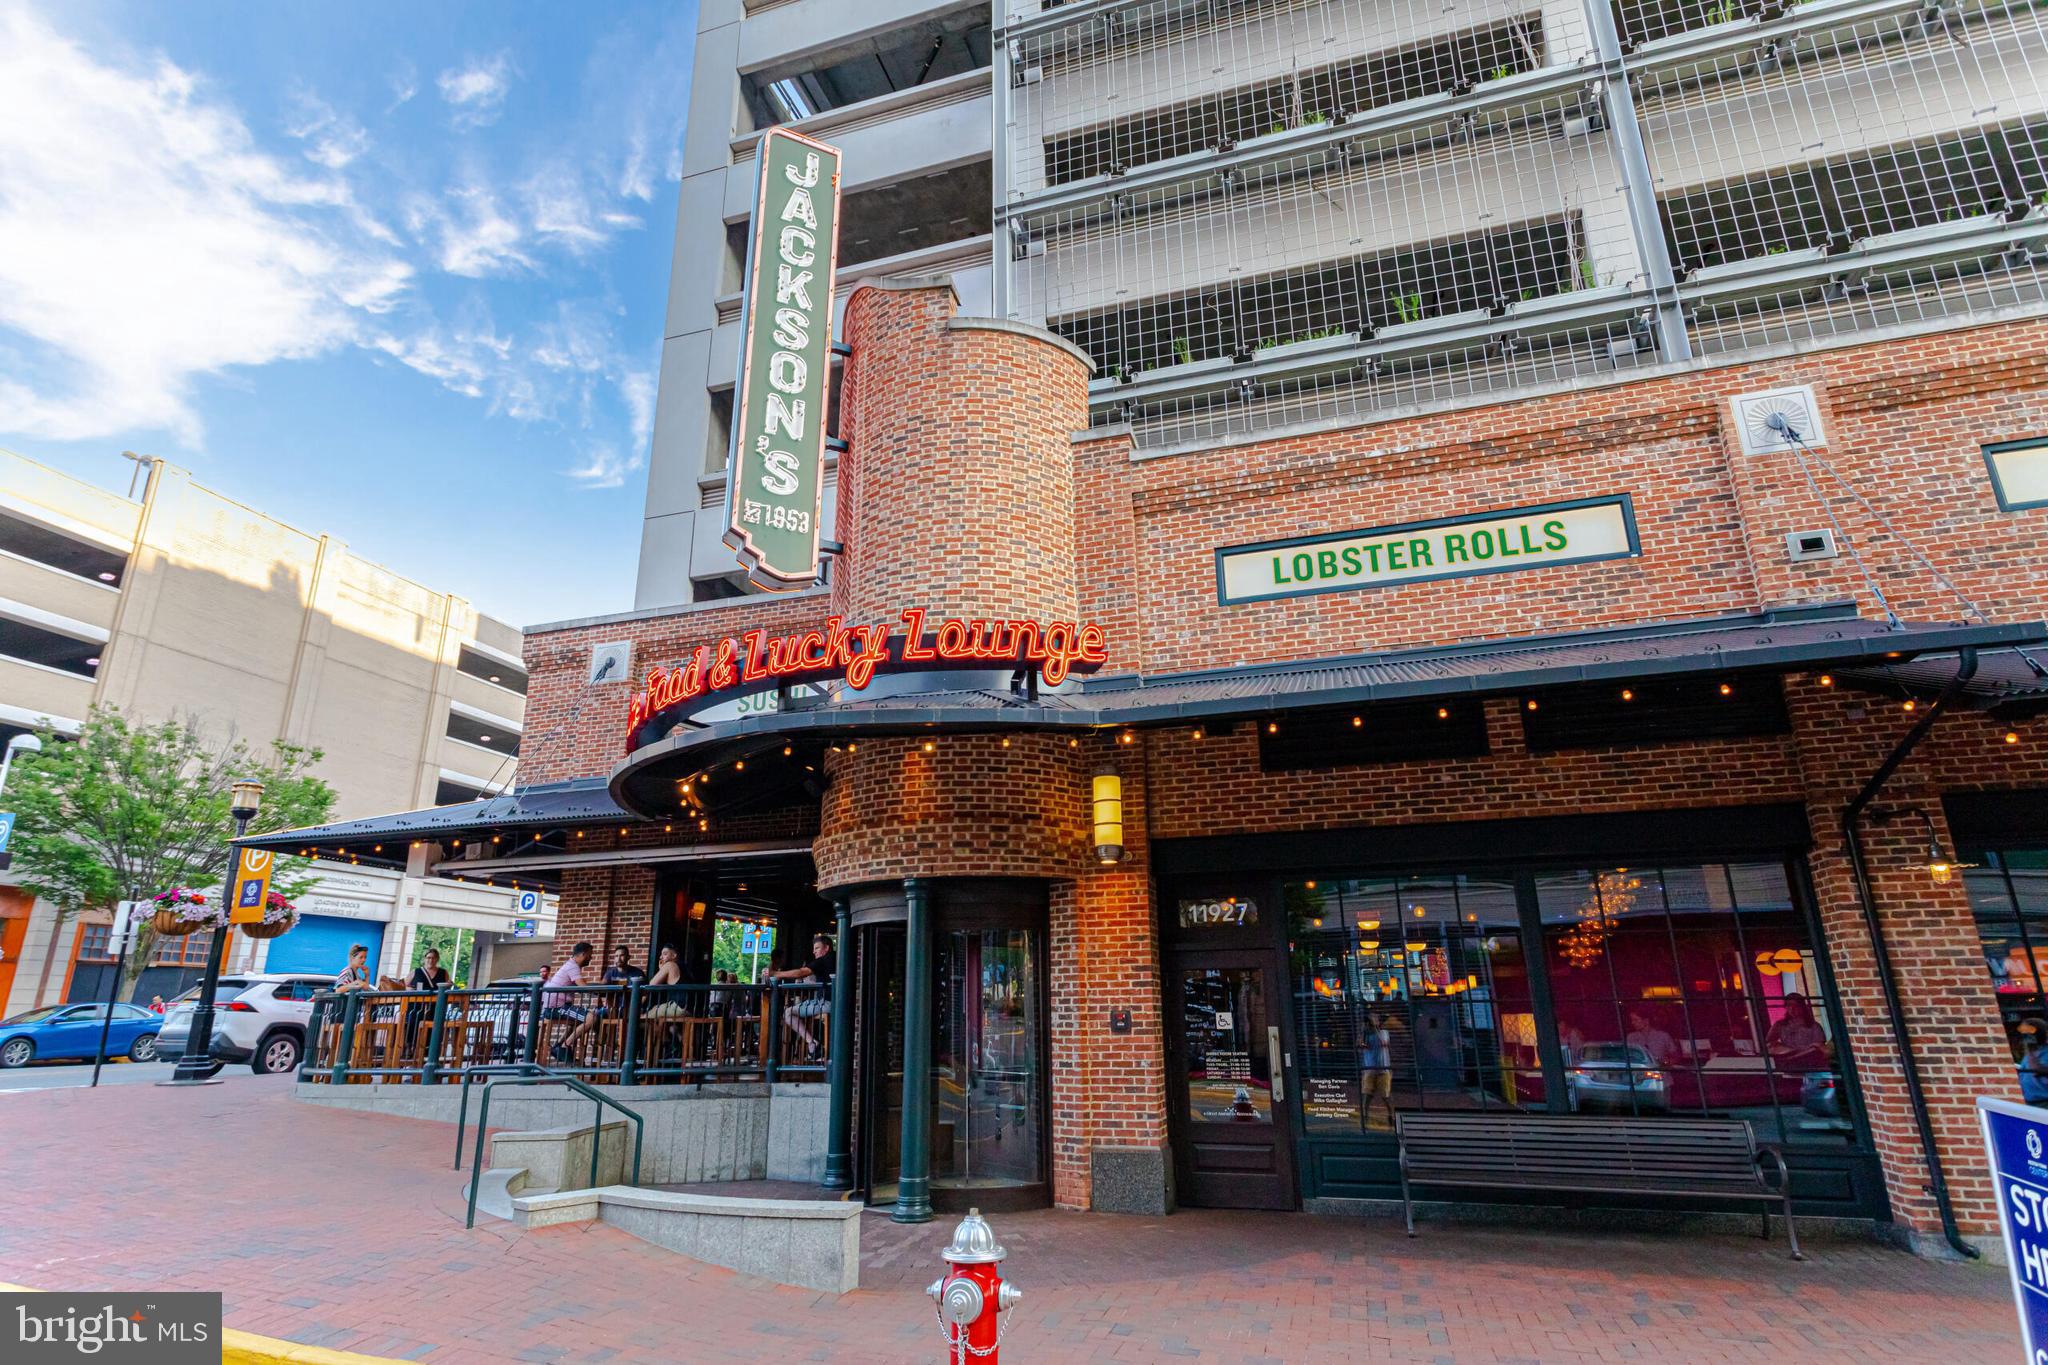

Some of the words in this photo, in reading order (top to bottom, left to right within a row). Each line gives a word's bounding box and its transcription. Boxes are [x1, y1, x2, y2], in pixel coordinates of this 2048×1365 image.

[756, 152, 820, 495] JACKSON'S
[765, 504, 809, 534] 1953
[1273, 538, 1433, 584] LOBSTER
[1444, 520, 1568, 564] ROLLS
[645, 646, 707, 719] Food
[710, 637, 737, 690] &
[743, 616, 890, 691] Lucky
[902, 607, 1108, 688] Lounge
[1188, 903, 1248, 923] 11927
